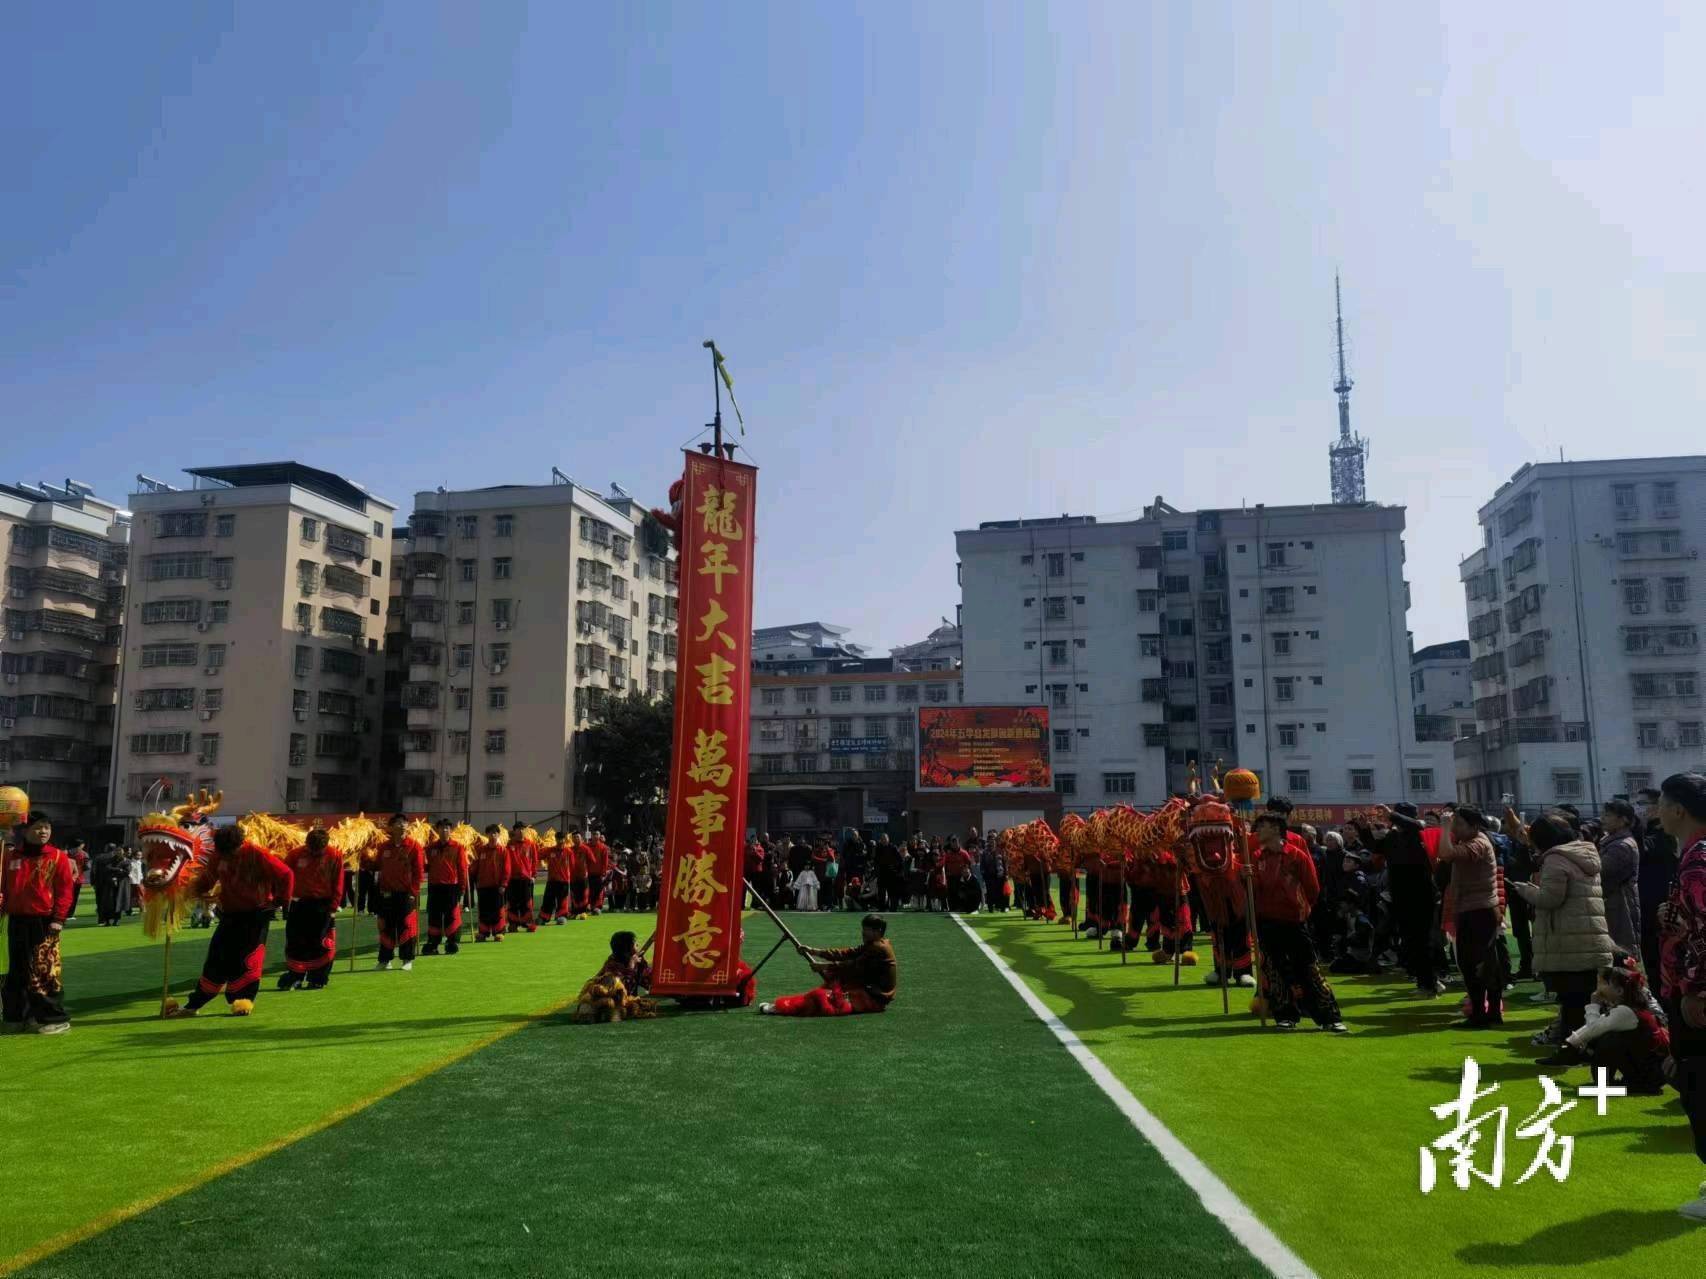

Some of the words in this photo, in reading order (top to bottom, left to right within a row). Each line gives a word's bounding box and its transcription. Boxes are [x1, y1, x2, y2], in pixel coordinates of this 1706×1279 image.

[695, 484, 743, 706] 龍年大吉
[672, 728, 733, 968] 萬事勝意
